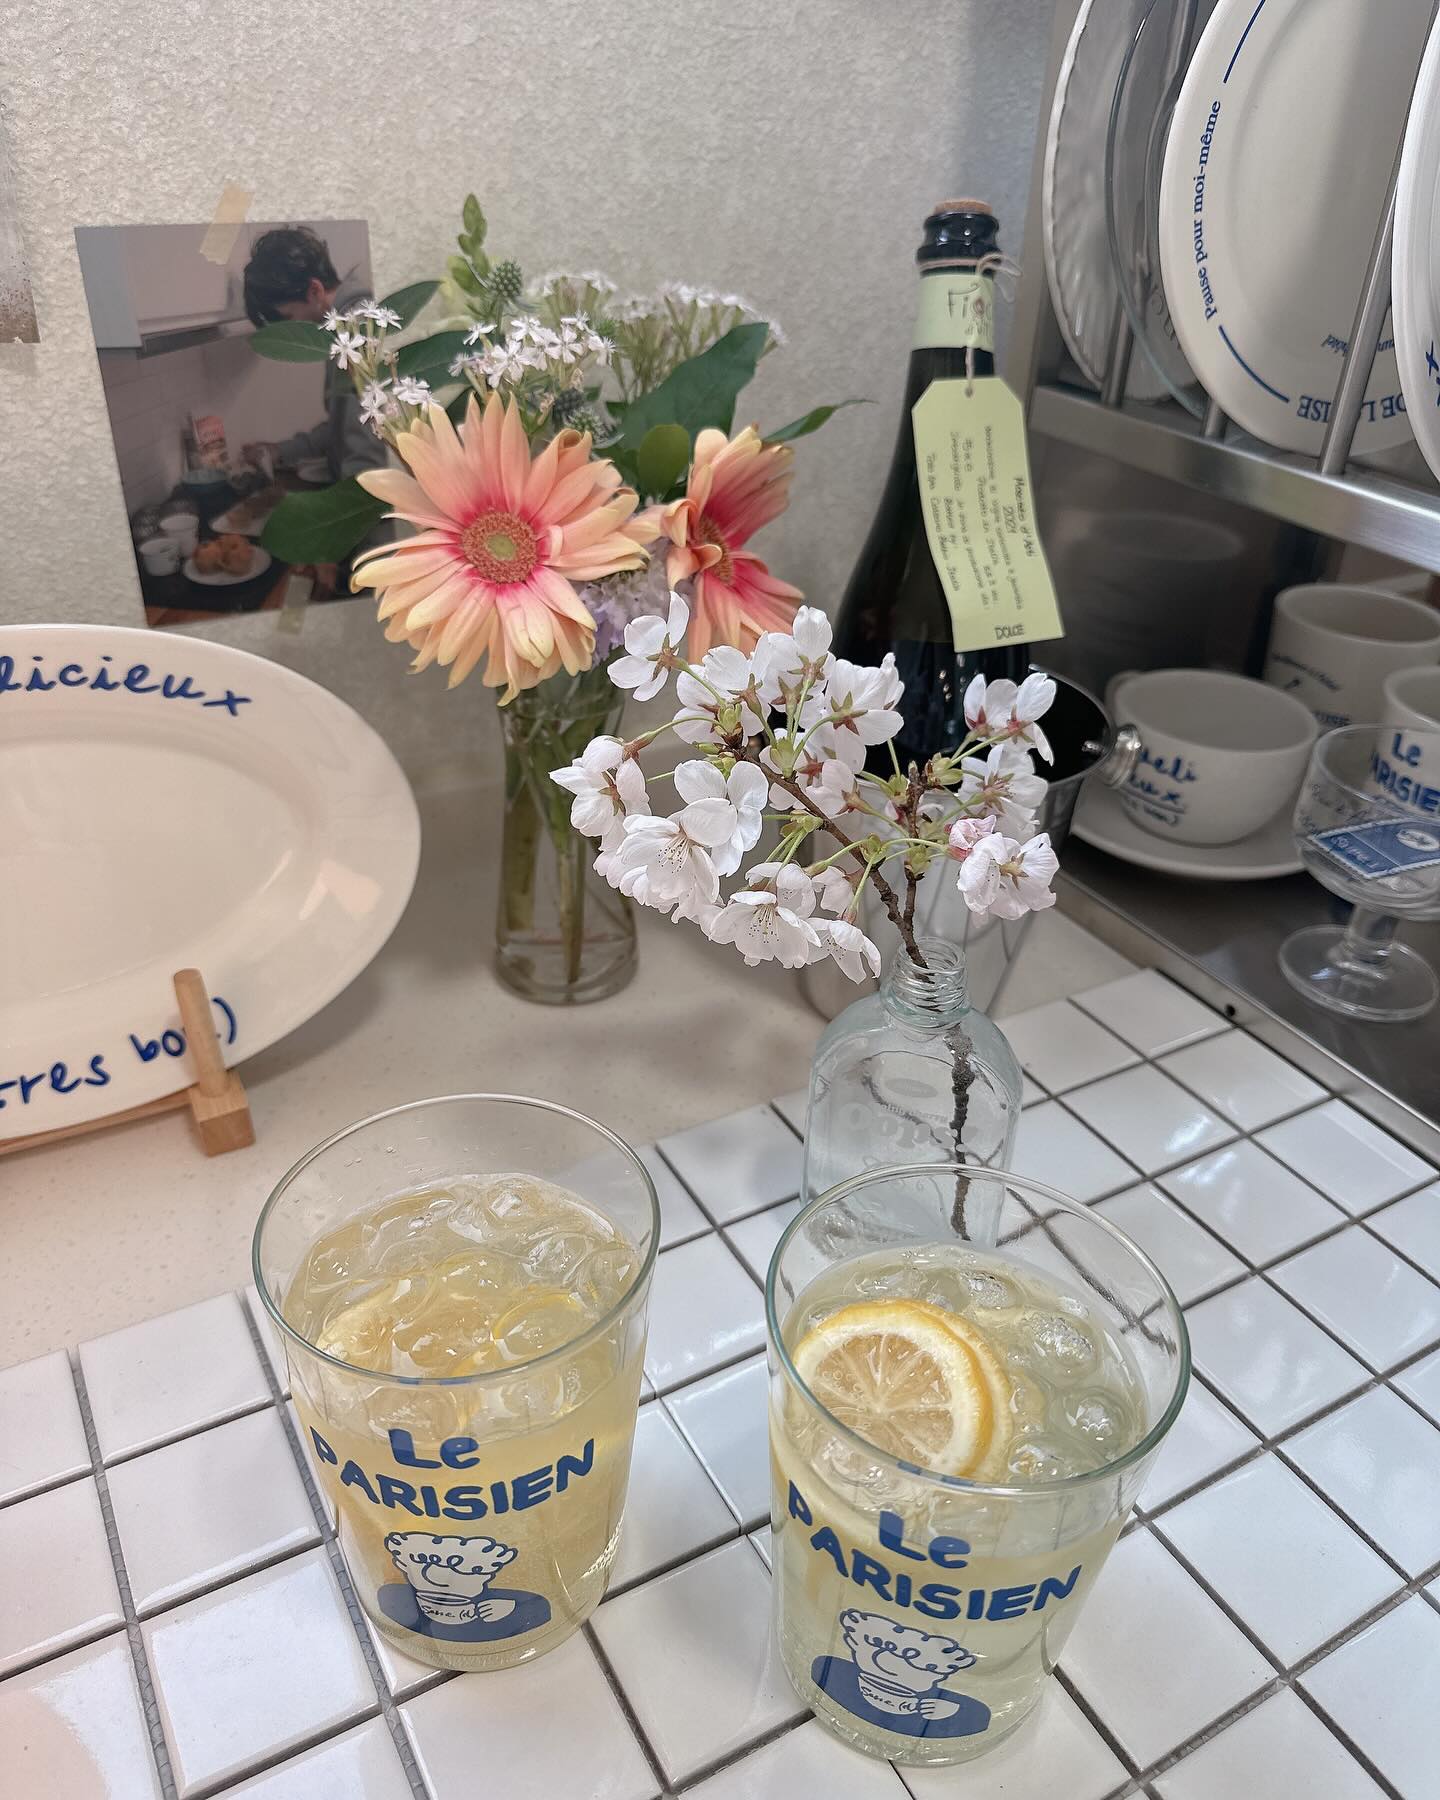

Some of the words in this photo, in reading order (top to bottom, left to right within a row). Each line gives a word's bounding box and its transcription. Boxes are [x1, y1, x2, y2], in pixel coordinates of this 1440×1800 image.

[1193, 100, 1221, 214] moi-même
[1193, 219, 1208, 263] pour
[1197, 267, 1218, 321] Pause
[994, 623, 1024, 641] DOLCE
[1391, 732, 1422, 768] Le
[128, 997, 237, 1063] bo)
[309, 1425, 595, 1521] PARISIEN
[387, 1428, 481, 1469] Le
[788, 1479, 1083, 1622] PARISIEN
[878, 1509, 972, 1570] Le
